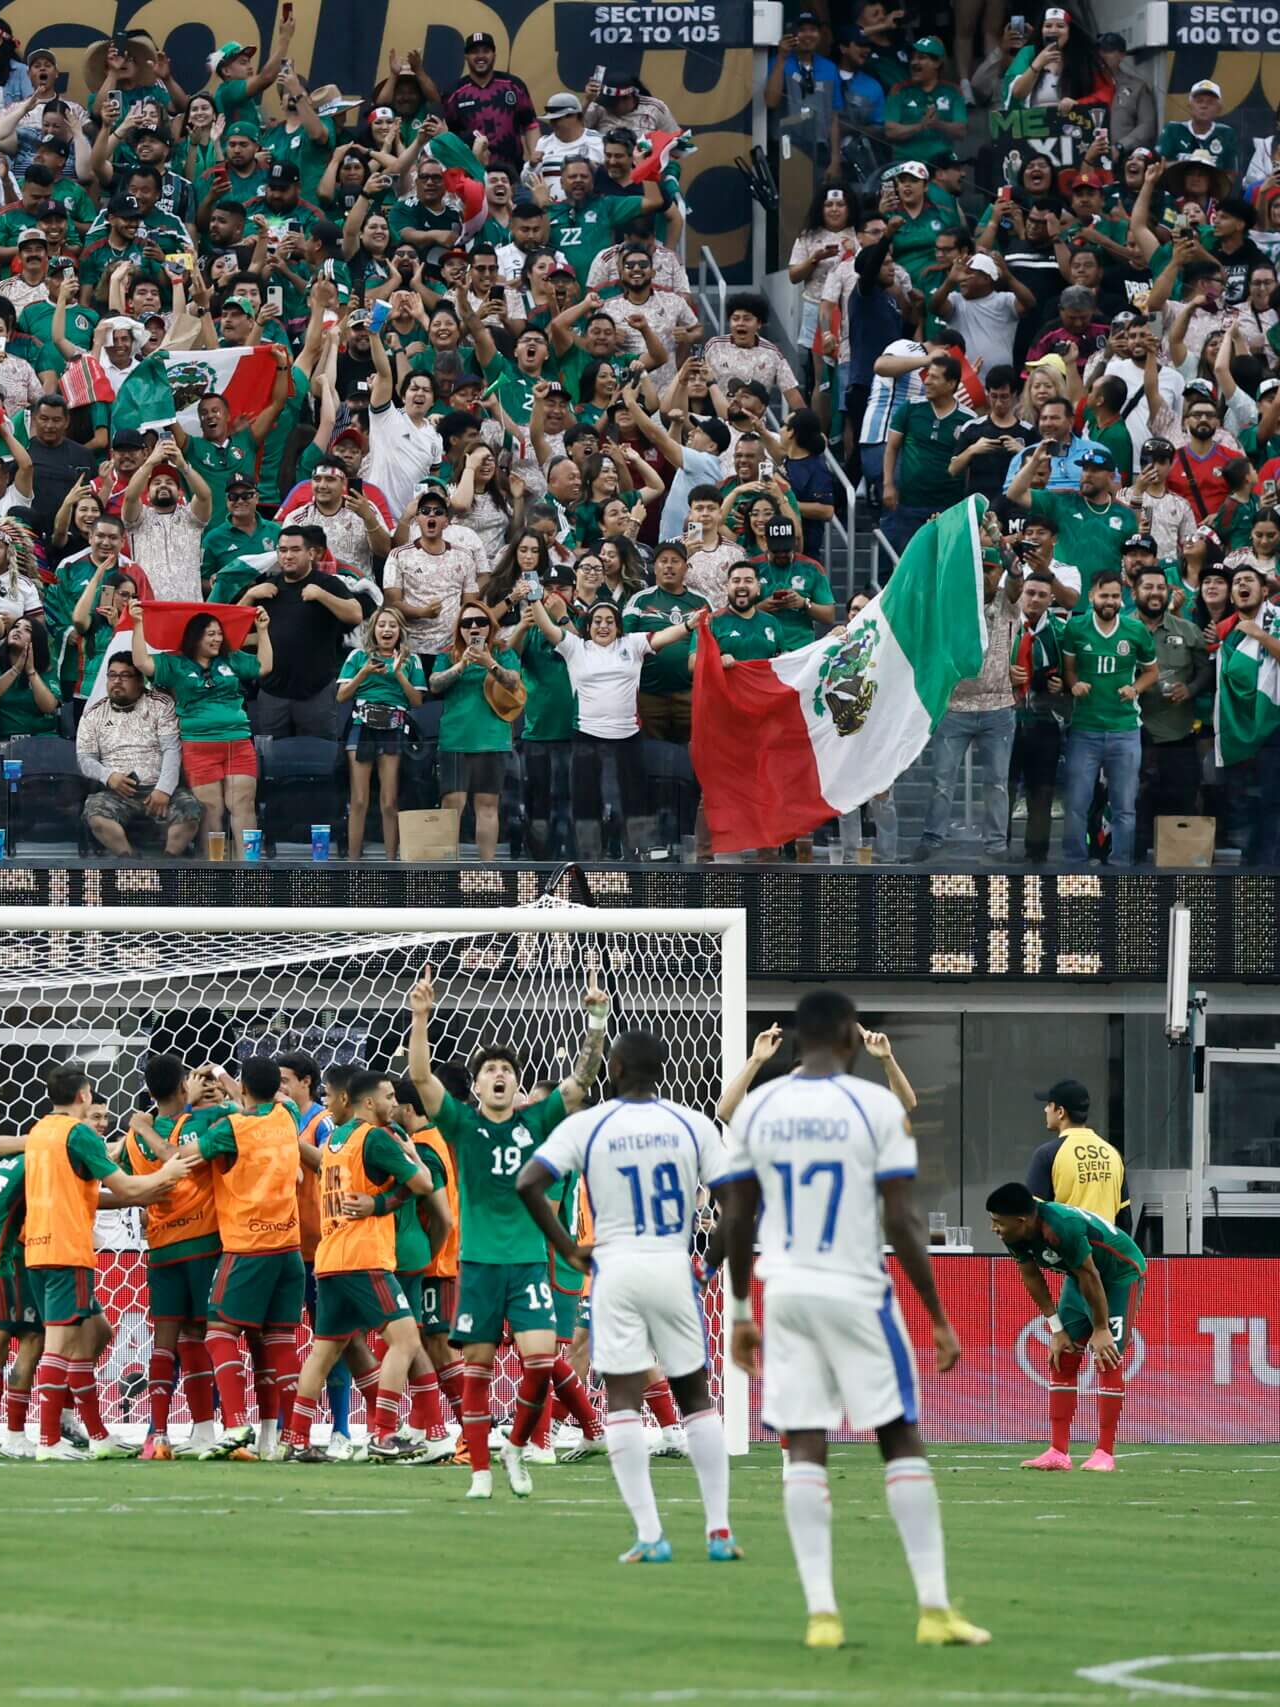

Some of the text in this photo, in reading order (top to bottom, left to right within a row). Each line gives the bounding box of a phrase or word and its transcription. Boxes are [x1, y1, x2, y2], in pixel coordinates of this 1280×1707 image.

[594, 6, 716, 23] SECTIONS
[590, 25, 721, 44] 102 TO 105
[1176, 27, 1221, 44] 100
[1227, 27, 1260, 45] TO
[991, 107, 1050, 139] ME
[560, 227, 582, 247] 22
[769, 525, 793, 537] ICON
[1097, 655, 1115, 674] 10
[760, 1117, 850, 1144] FAJARDO
[609, 1134, 680, 1151] WATERMAN
[491, 1146, 521, 1175] 19
[1074, 1145, 1110, 1161] CSC
[1077, 1161, 1111, 1173] EVENT
[1079, 1172, 1112, 1184] STAFF
[322, 1191, 344, 1219] FINA
[617, 1161, 685, 1237] 18
[772, 1160, 844, 1253] 17
[525, 1282, 553, 1310] 19
